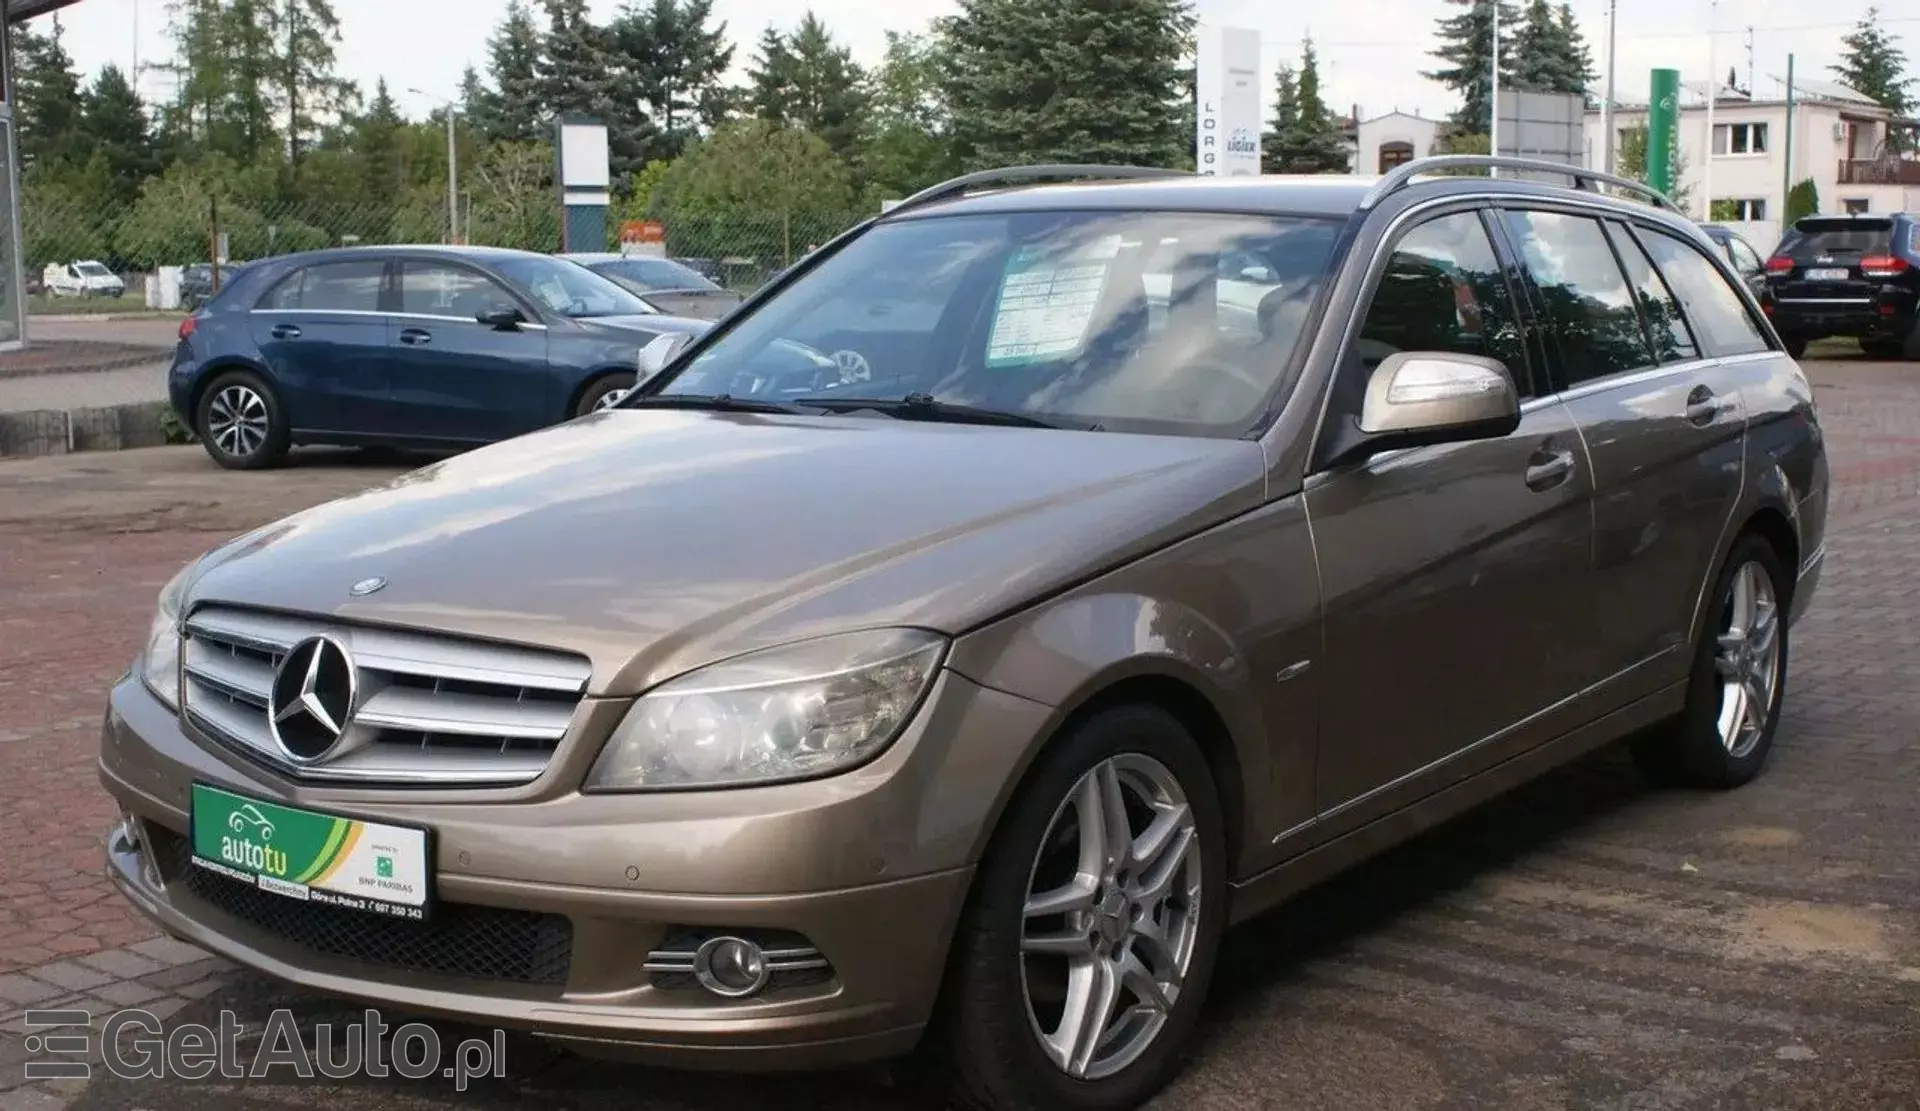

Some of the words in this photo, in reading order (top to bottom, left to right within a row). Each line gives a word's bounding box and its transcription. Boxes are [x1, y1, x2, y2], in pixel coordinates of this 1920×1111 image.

[221, 835, 288, 877] autotu
[358, 878, 376, 888] BNP
[376, 880, 414, 894] PARIBAS
